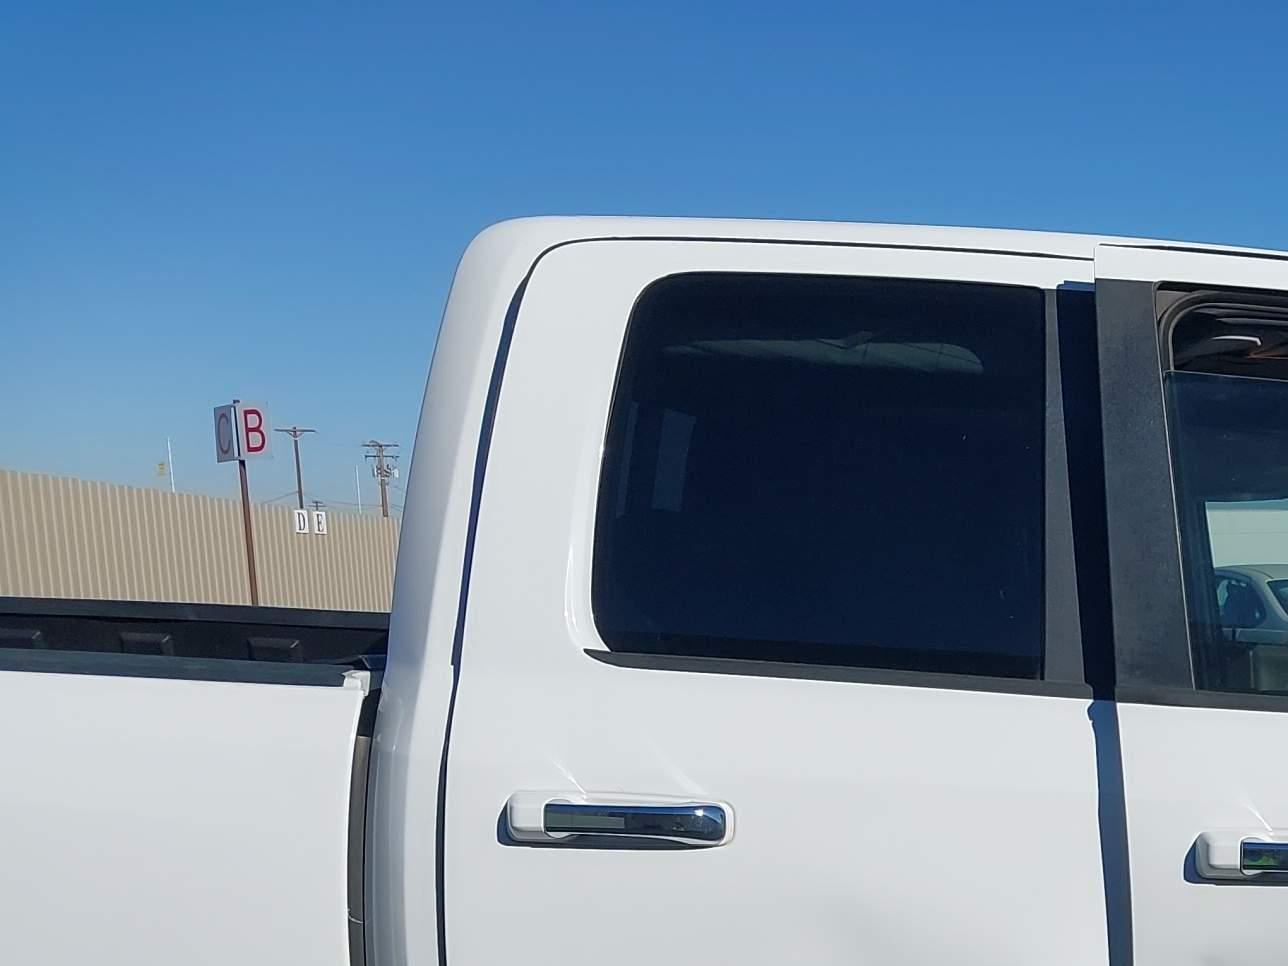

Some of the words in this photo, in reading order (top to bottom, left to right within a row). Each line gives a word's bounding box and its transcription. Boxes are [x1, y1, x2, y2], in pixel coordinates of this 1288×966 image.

[217, 412, 232, 454] C
[243, 409, 266, 453] B
[297, 512, 306, 531] D
[316, 513, 324, 532] E
